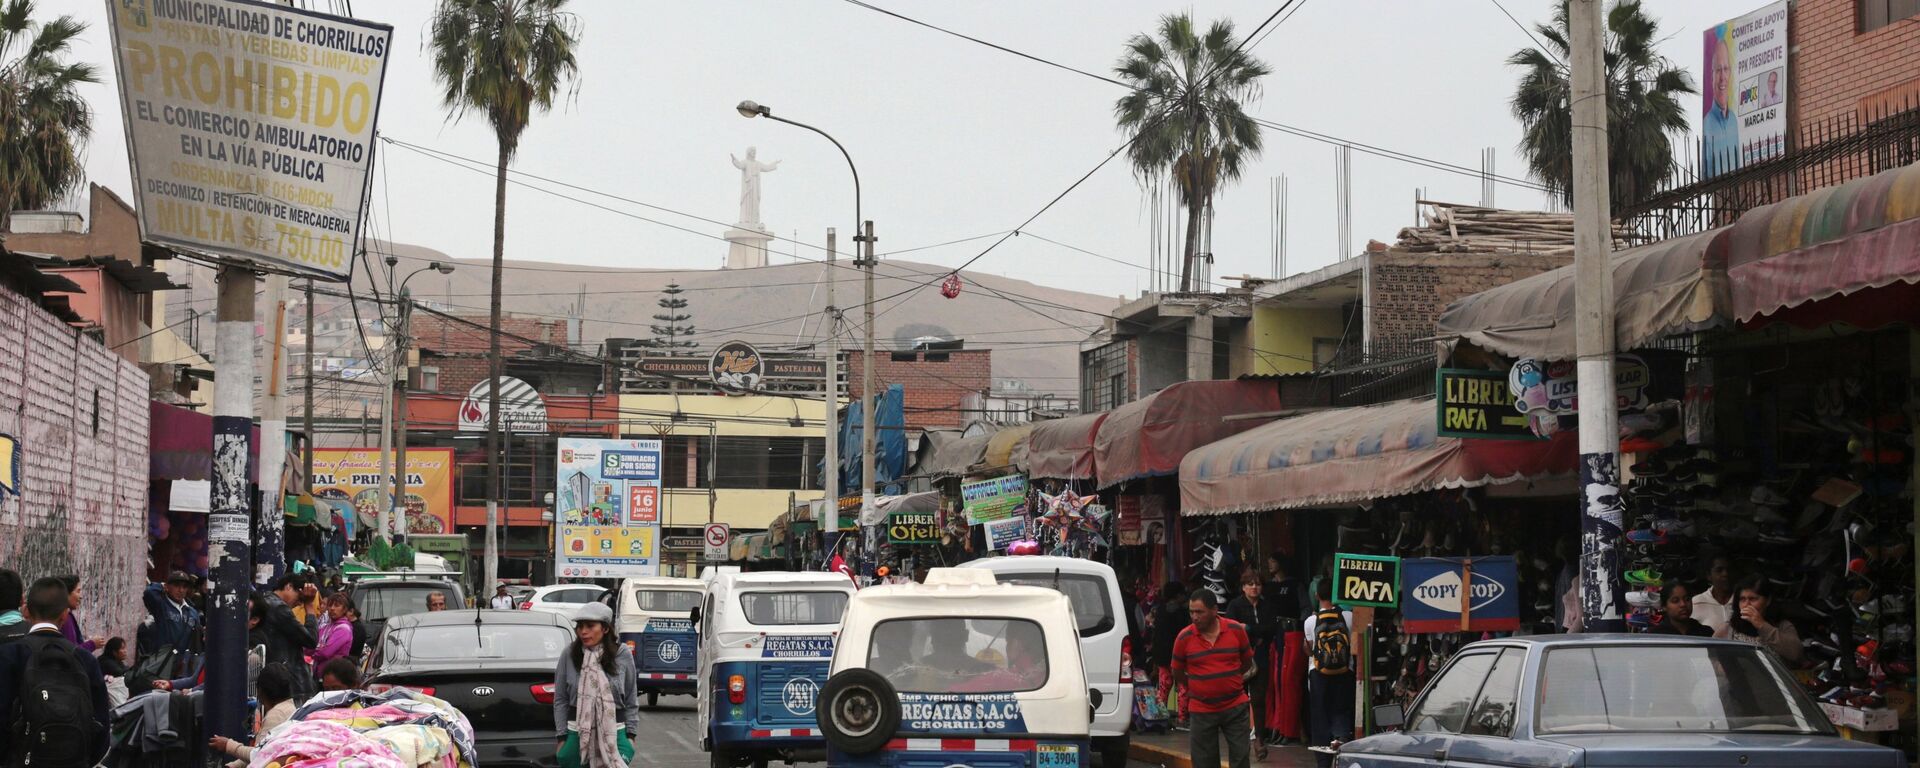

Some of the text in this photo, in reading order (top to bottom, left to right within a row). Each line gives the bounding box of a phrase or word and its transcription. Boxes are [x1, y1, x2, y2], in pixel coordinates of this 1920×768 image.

[154, 0, 384, 58] MUNICIPALIDAD DE CHORRILLOS
[1731, 10, 1785, 39] COMITE DE APOYO
[225, 31, 236, 49] Y
[242, 35, 308, 63] VEREDAS
[1738, 29, 1774, 52] CHORRILLOS
[1749, 45, 1783, 69] PRESIDENTE
[124, 39, 371, 135] PROHIBIDO
[1744, 111, 1764, 128] MARCA
[136, 100, 363, 163] EL COMERCIO AMBULATORIO
[180, 134, 324, 183] EN LA VÍA PÚBLICA
[171, 161, 250, 192] ORDENANZA
[272, 180, 334, 209] 016-MDCH
[148, 178, 205, 203] DECOMIZO
[213, 190, 271, 217] RETENCIÓN
[274, 200, 287, 219] DE
[289, 207, 350, 235] MERCADERIA
[156, 199, 235, 243] MULTA
[275, 223, 344, 268] 750.00
[643, 363, 707, 372] CHICHARRONES
[774, 365, 822, 373] PASTELERIA
[1445, 377, 1515, 405] LIBRER
[1446, 407, 1487, 430] RAFA
[633, 495, 654, 507] 16
[895, 515, 934, 525] LIBRER
[1340, 559, 1383, 572] LIBRERIA
[1345, 576, 1393, 601] RAFA
[1418, 583, 1498, 598] TOPY TOP
[661, 643, 678, 659] 456
[767, 640, 806, 650] REGATAS
[899, 694, 1017, 702] EMP. VEHIC. MENORES
[902, 703, 972, 720] REGATAS
[911, 721, 1006, 729] CHORRILLOS
